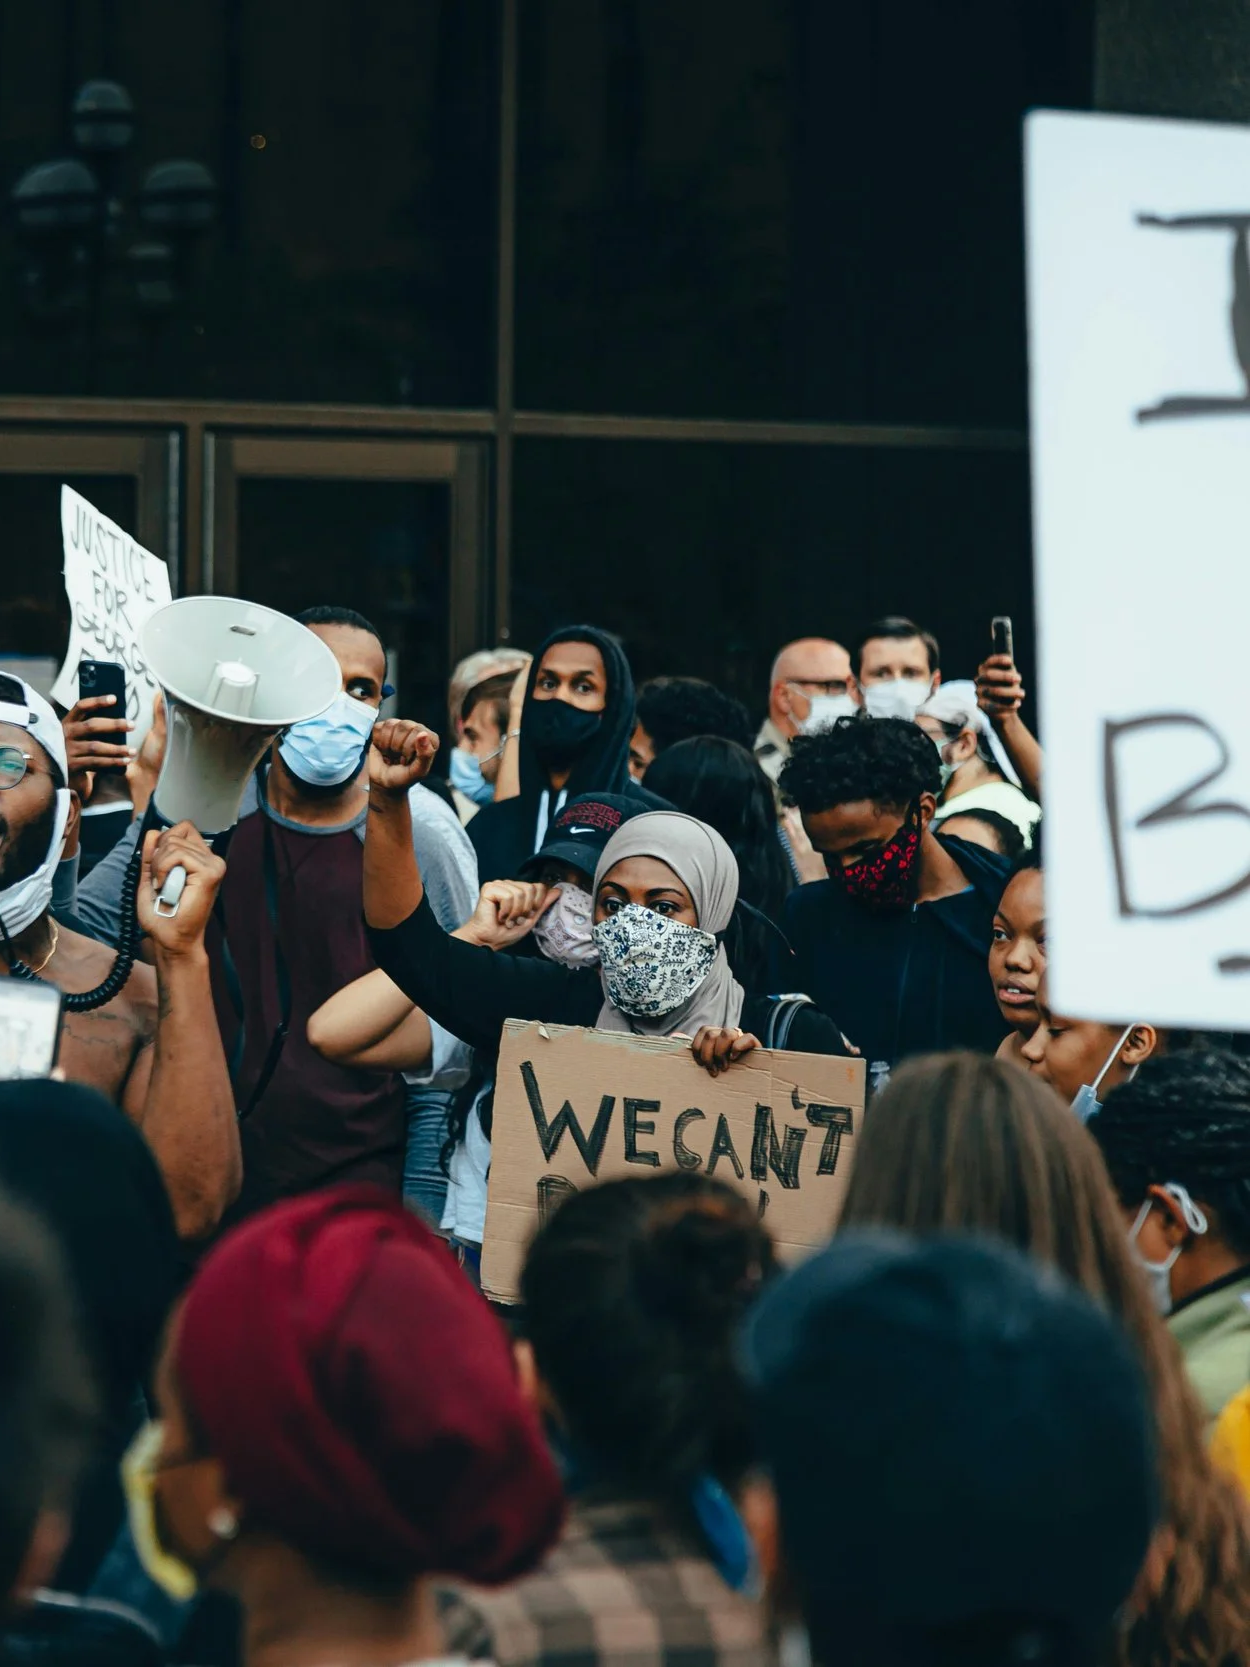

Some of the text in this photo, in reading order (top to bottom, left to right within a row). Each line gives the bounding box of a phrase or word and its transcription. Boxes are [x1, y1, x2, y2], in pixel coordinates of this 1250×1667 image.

[70, 503, 156, 603] JUSTICE
[92, 569, 134, 633] FOR
[519, 1060, 854, 1190] WE CAN'T
